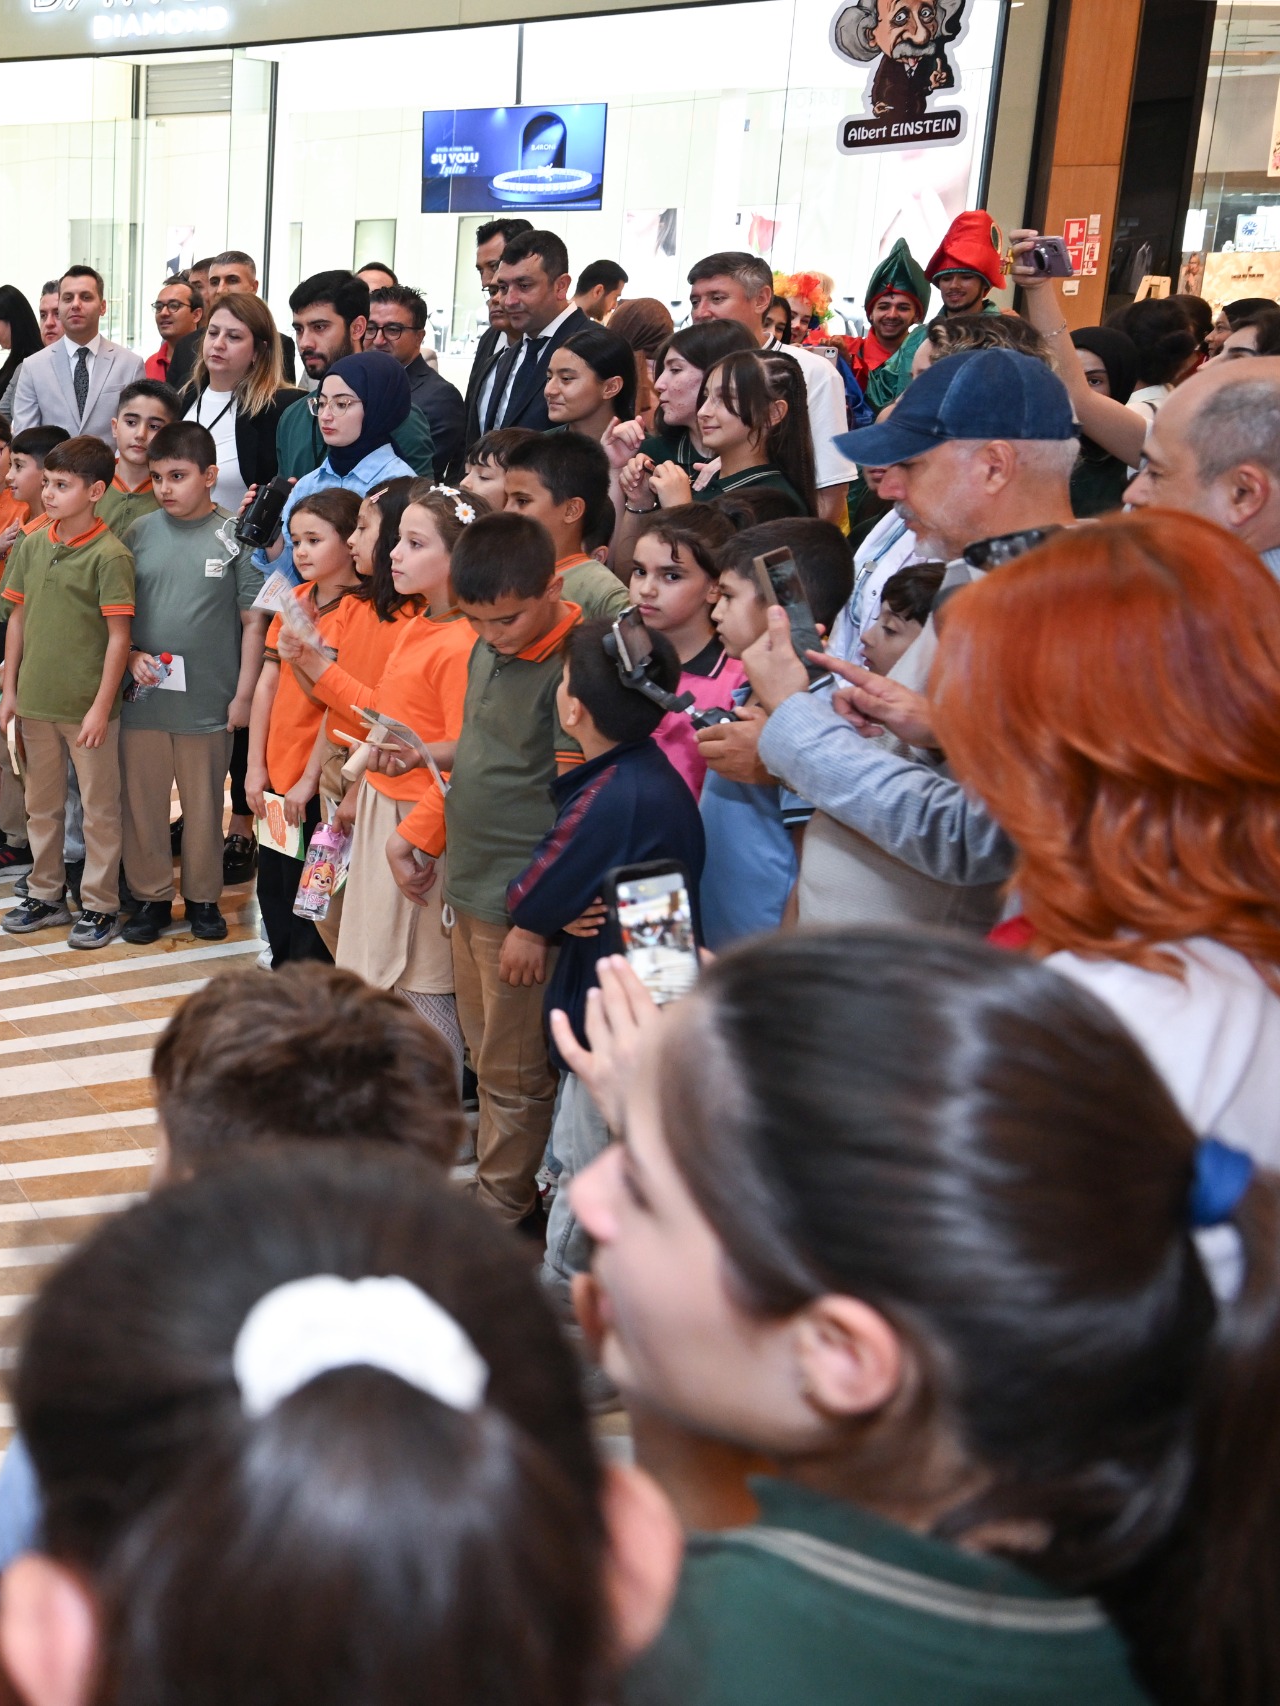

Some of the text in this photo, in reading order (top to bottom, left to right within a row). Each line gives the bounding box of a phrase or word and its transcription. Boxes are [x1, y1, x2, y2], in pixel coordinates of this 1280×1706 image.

[93, 6, 228, 39] DIAMOND
[847, 117, 957, 141] Albert EINSTEIN
